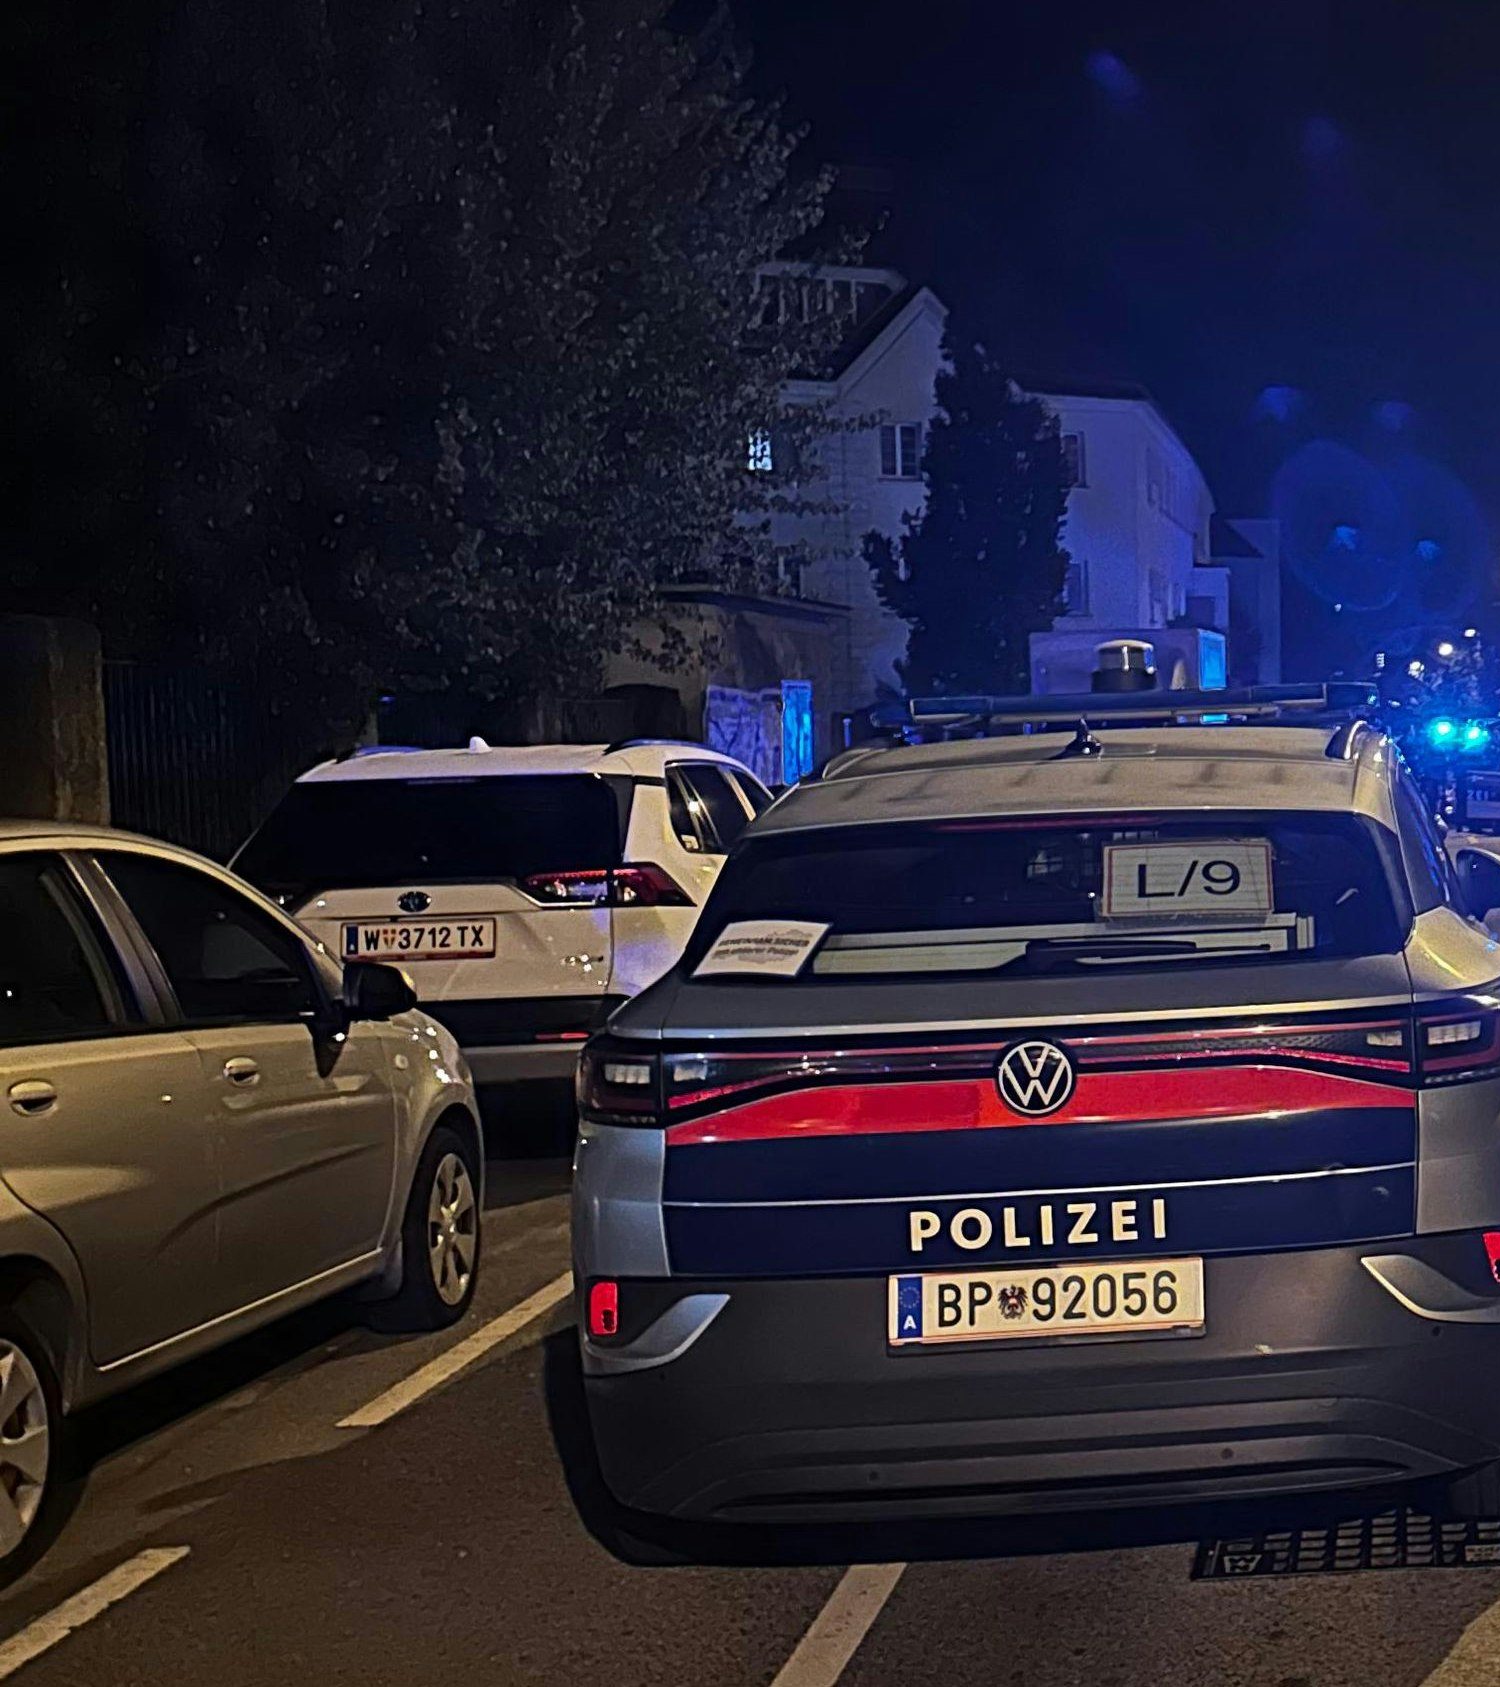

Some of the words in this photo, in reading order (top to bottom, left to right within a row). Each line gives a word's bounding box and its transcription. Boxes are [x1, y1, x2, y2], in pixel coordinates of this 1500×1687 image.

[1137, 859, 1241, 899] L/9
[364, 929, 380, 951] W
[398, 927, 451, 949] 3712
[457, 925, 484, 947] TX
[909, 1198, 1166, 1252] POLIZEI
[937, 1280, 993, 1328] BP
[1031, 1270, 1178, 1322] 92056
[903, 1315, 917, 1330] A
